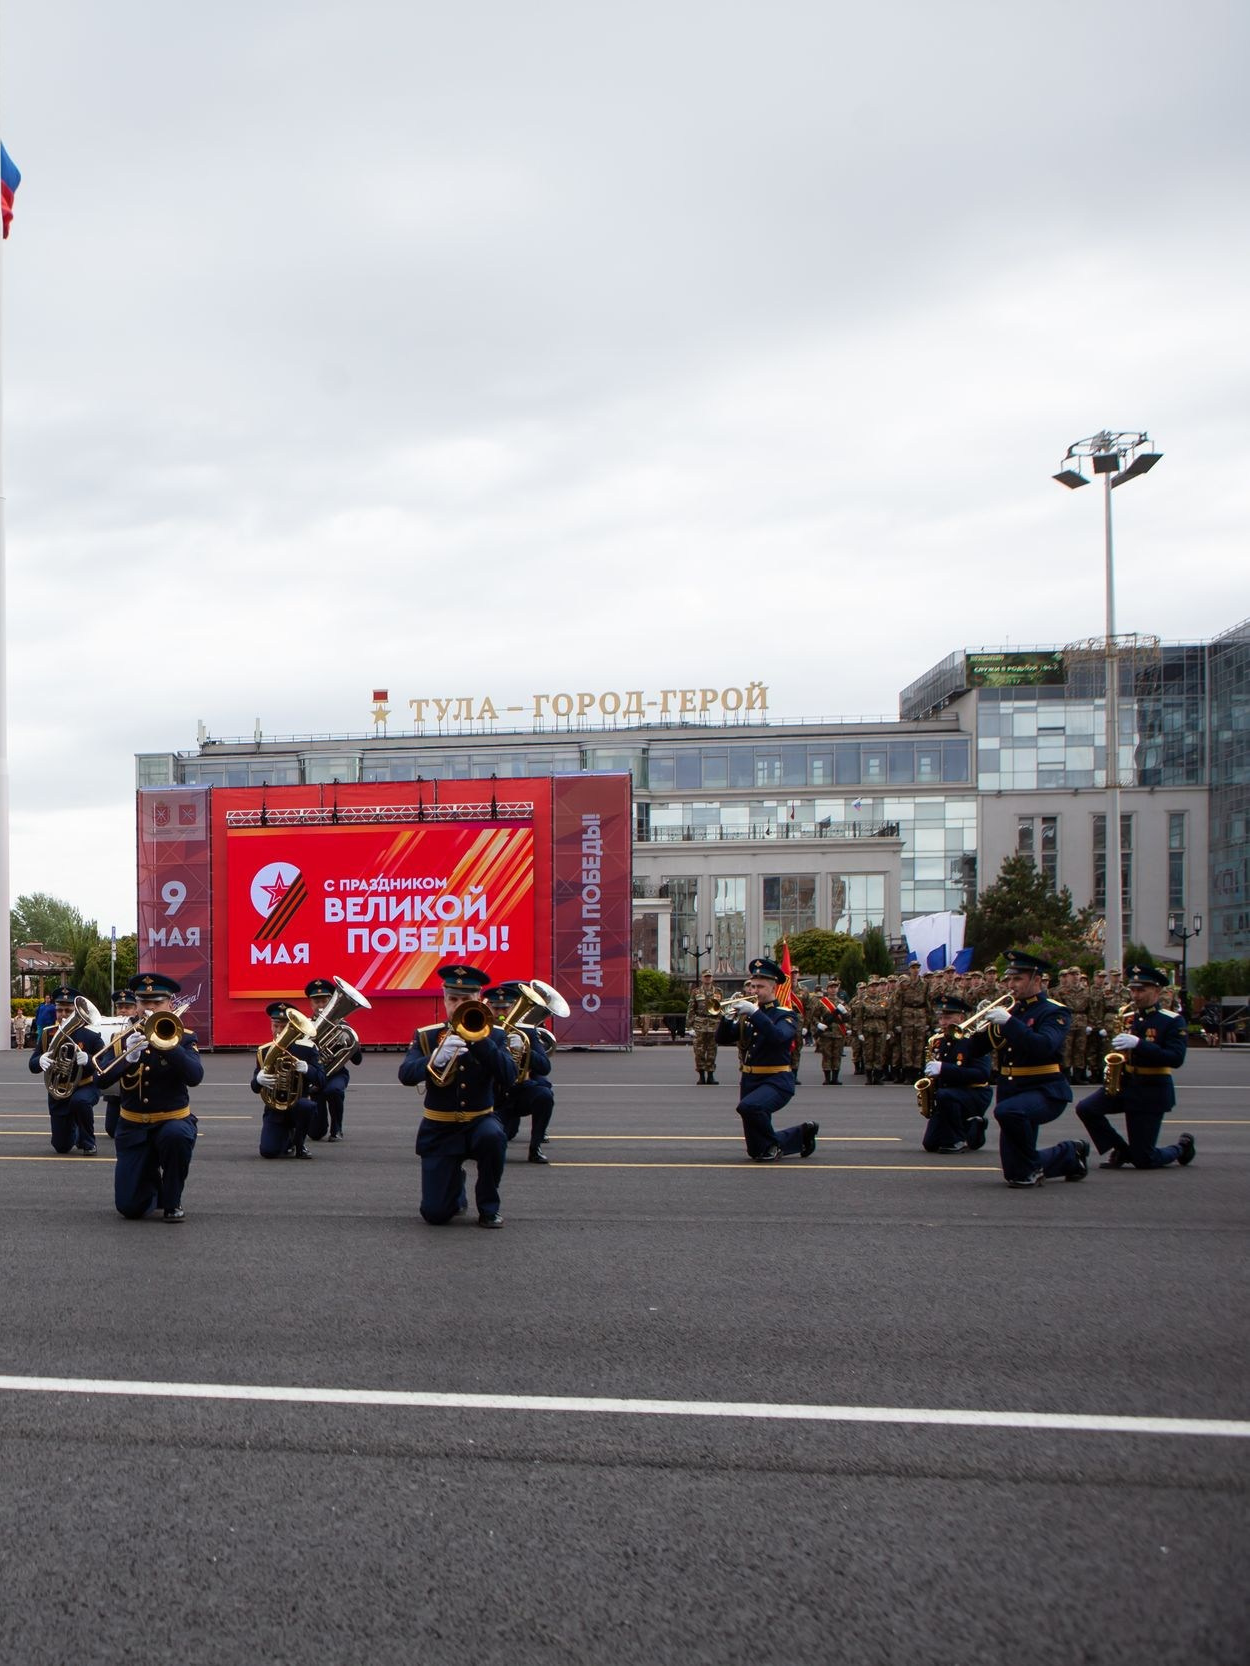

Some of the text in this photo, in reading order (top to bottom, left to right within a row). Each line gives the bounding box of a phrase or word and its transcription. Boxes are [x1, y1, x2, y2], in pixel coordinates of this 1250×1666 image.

[161, 880, 187, 916] 9
[323, 876, 447, 893] С ПРАЗДНИКОМ
[324, 885, 488, 923] ВЕЛИКОЙ
[577, 813, 604, 1013] С ДНЁМ ПОБЕДЫ!
[148, 926, 201, 947] МАЯ
[347, 925, 510, 957] ПОБЕДЫ!
[250, 943, 310, 965] МАЯ
